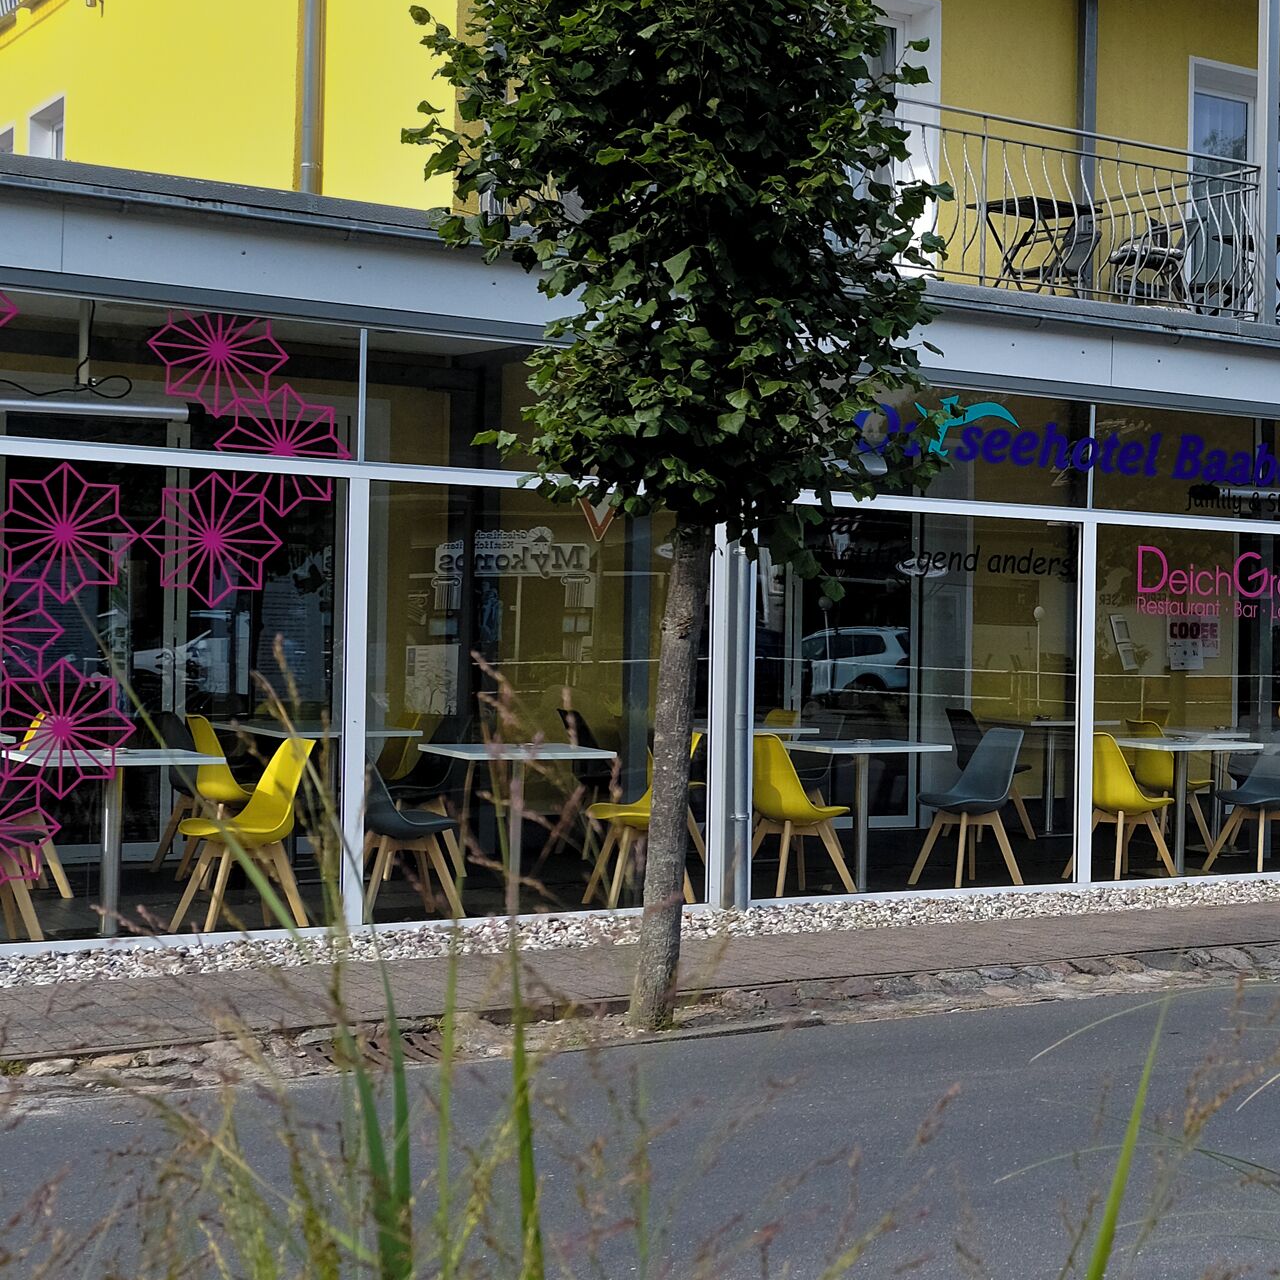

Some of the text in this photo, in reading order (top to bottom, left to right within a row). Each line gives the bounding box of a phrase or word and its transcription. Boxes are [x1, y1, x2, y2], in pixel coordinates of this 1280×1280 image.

[1185, 486, 1241, 514] family
[1249, 491, 1261, 511] &
[841, 546, 1072, 576] auegend anders
[1136, 596, 1220, 617] Restaurant
[1234, 601, 1257, 618] Bar
[1169, 621, 1219, 640] COOEE
